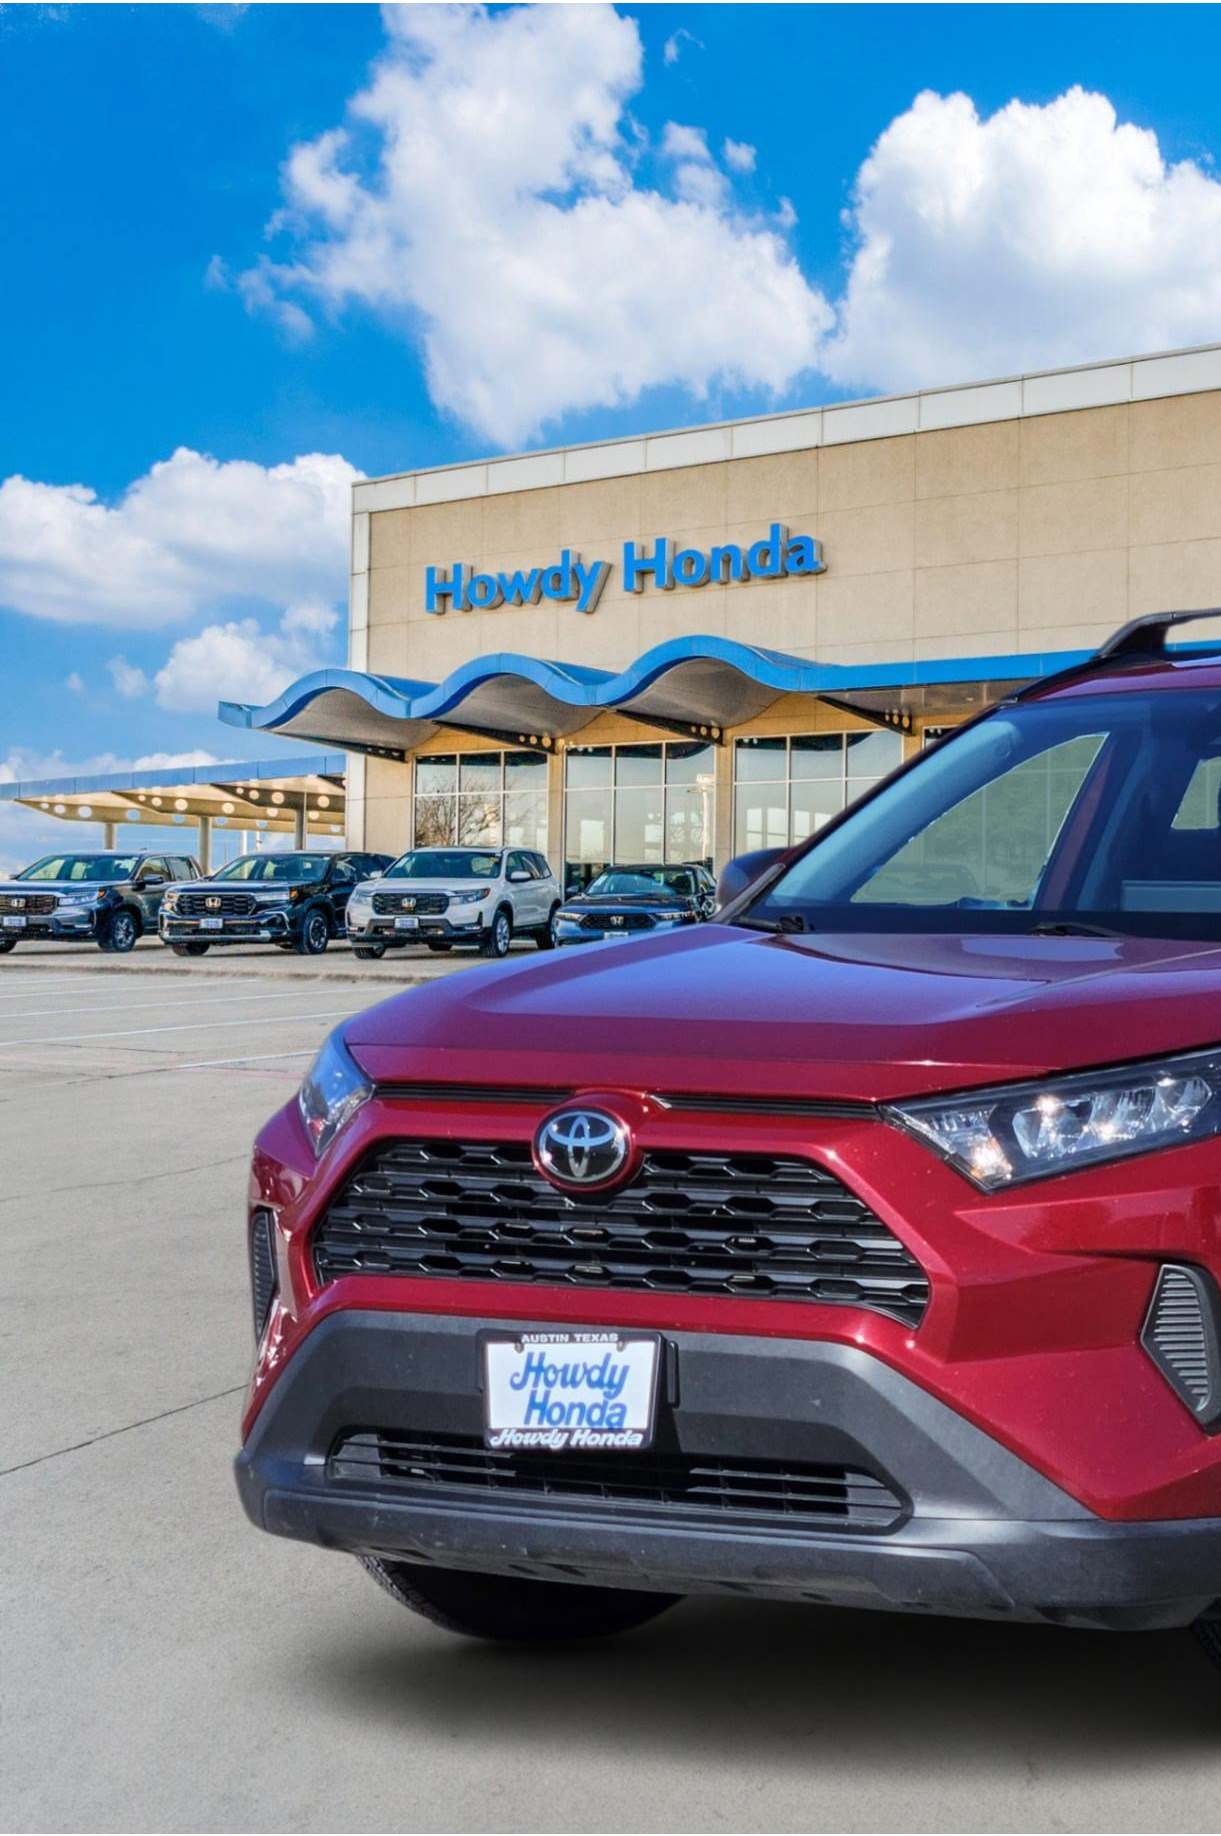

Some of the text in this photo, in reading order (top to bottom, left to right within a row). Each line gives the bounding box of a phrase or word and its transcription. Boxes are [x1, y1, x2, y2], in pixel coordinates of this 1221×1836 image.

[425, 523, 827, 614] Howdy Honda
[521, 1333, 619, 1344] AUSTIN TEXAS
[510, 1352, 630, 1399] Howdy
[524, 1390, 628, 1430] Honda
[490, 1428, 643, 1449] Howdy Honda
